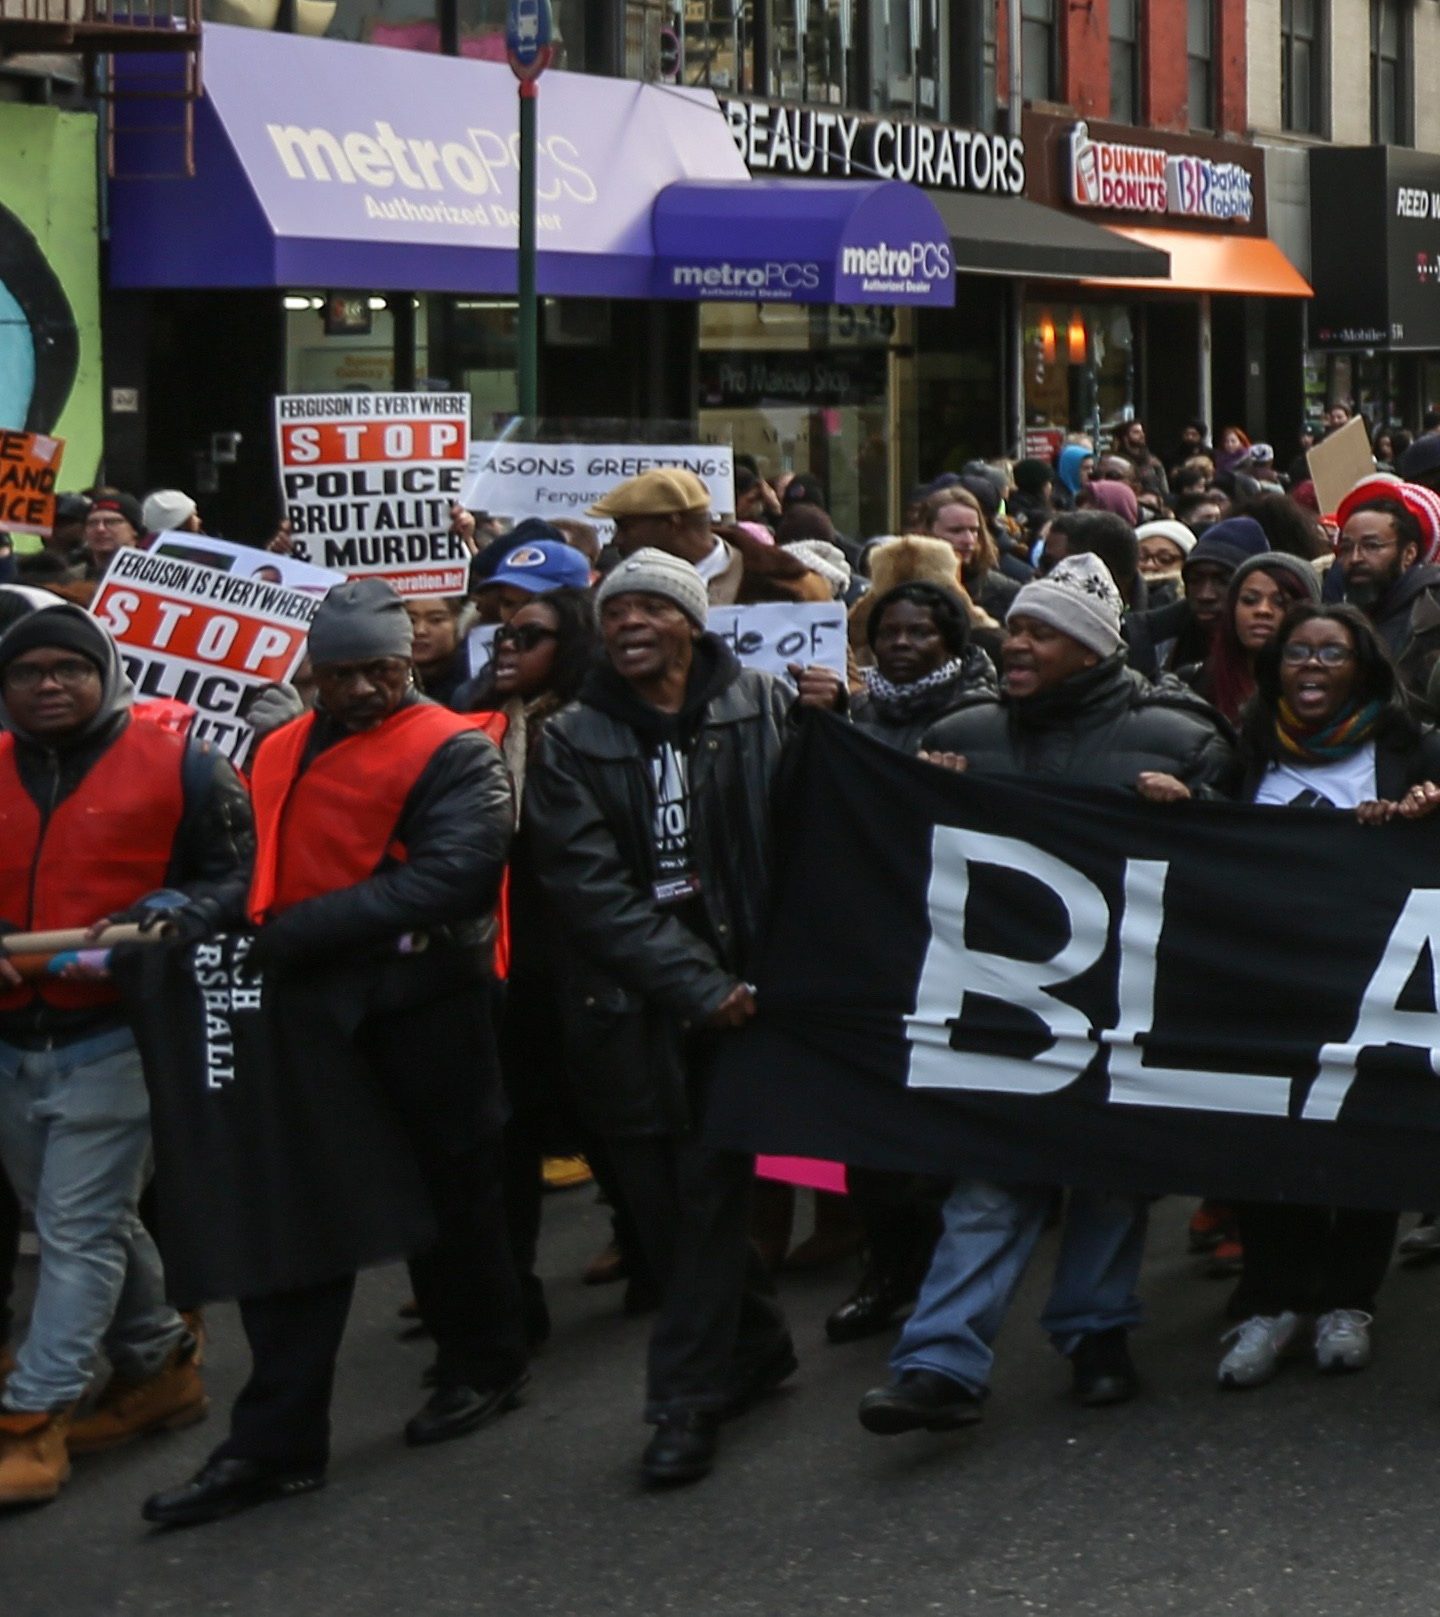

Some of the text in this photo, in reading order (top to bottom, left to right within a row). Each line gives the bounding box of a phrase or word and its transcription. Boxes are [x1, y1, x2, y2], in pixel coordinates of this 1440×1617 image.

[727, 100, 1025, 194] BEAUTY CURATORS
[1100, 144, 1168, 179] DUNKIN'
[363, 194, 562, 231] Authorized Deler
[1103, 177, 1167, 212] DONUTS
[1396, 187, 1431, 219] REED
[673, 262, 820, 289] metroPCS
[842, 242, 950, 280] metroPCS
[863, 278, 932, 293] Authorized Dealer
[280, 394, 467, 419] FERGUSON IS EVERYWHERE
[289, 423, 459, 463] STOP
[284, 466, 465, 501] POLICE
[467, 455, 575, 478] EASONS
[324, 532, 465, 569] MURDER
[112, 551, 190, 597] FERGUSON
[192, 569, 212, 598] IS
[210, 575, 321, 624] EVERYWHERE
[102, 590, 292, 672] STOP
[195, 933, 236, 1089] RSHALL
